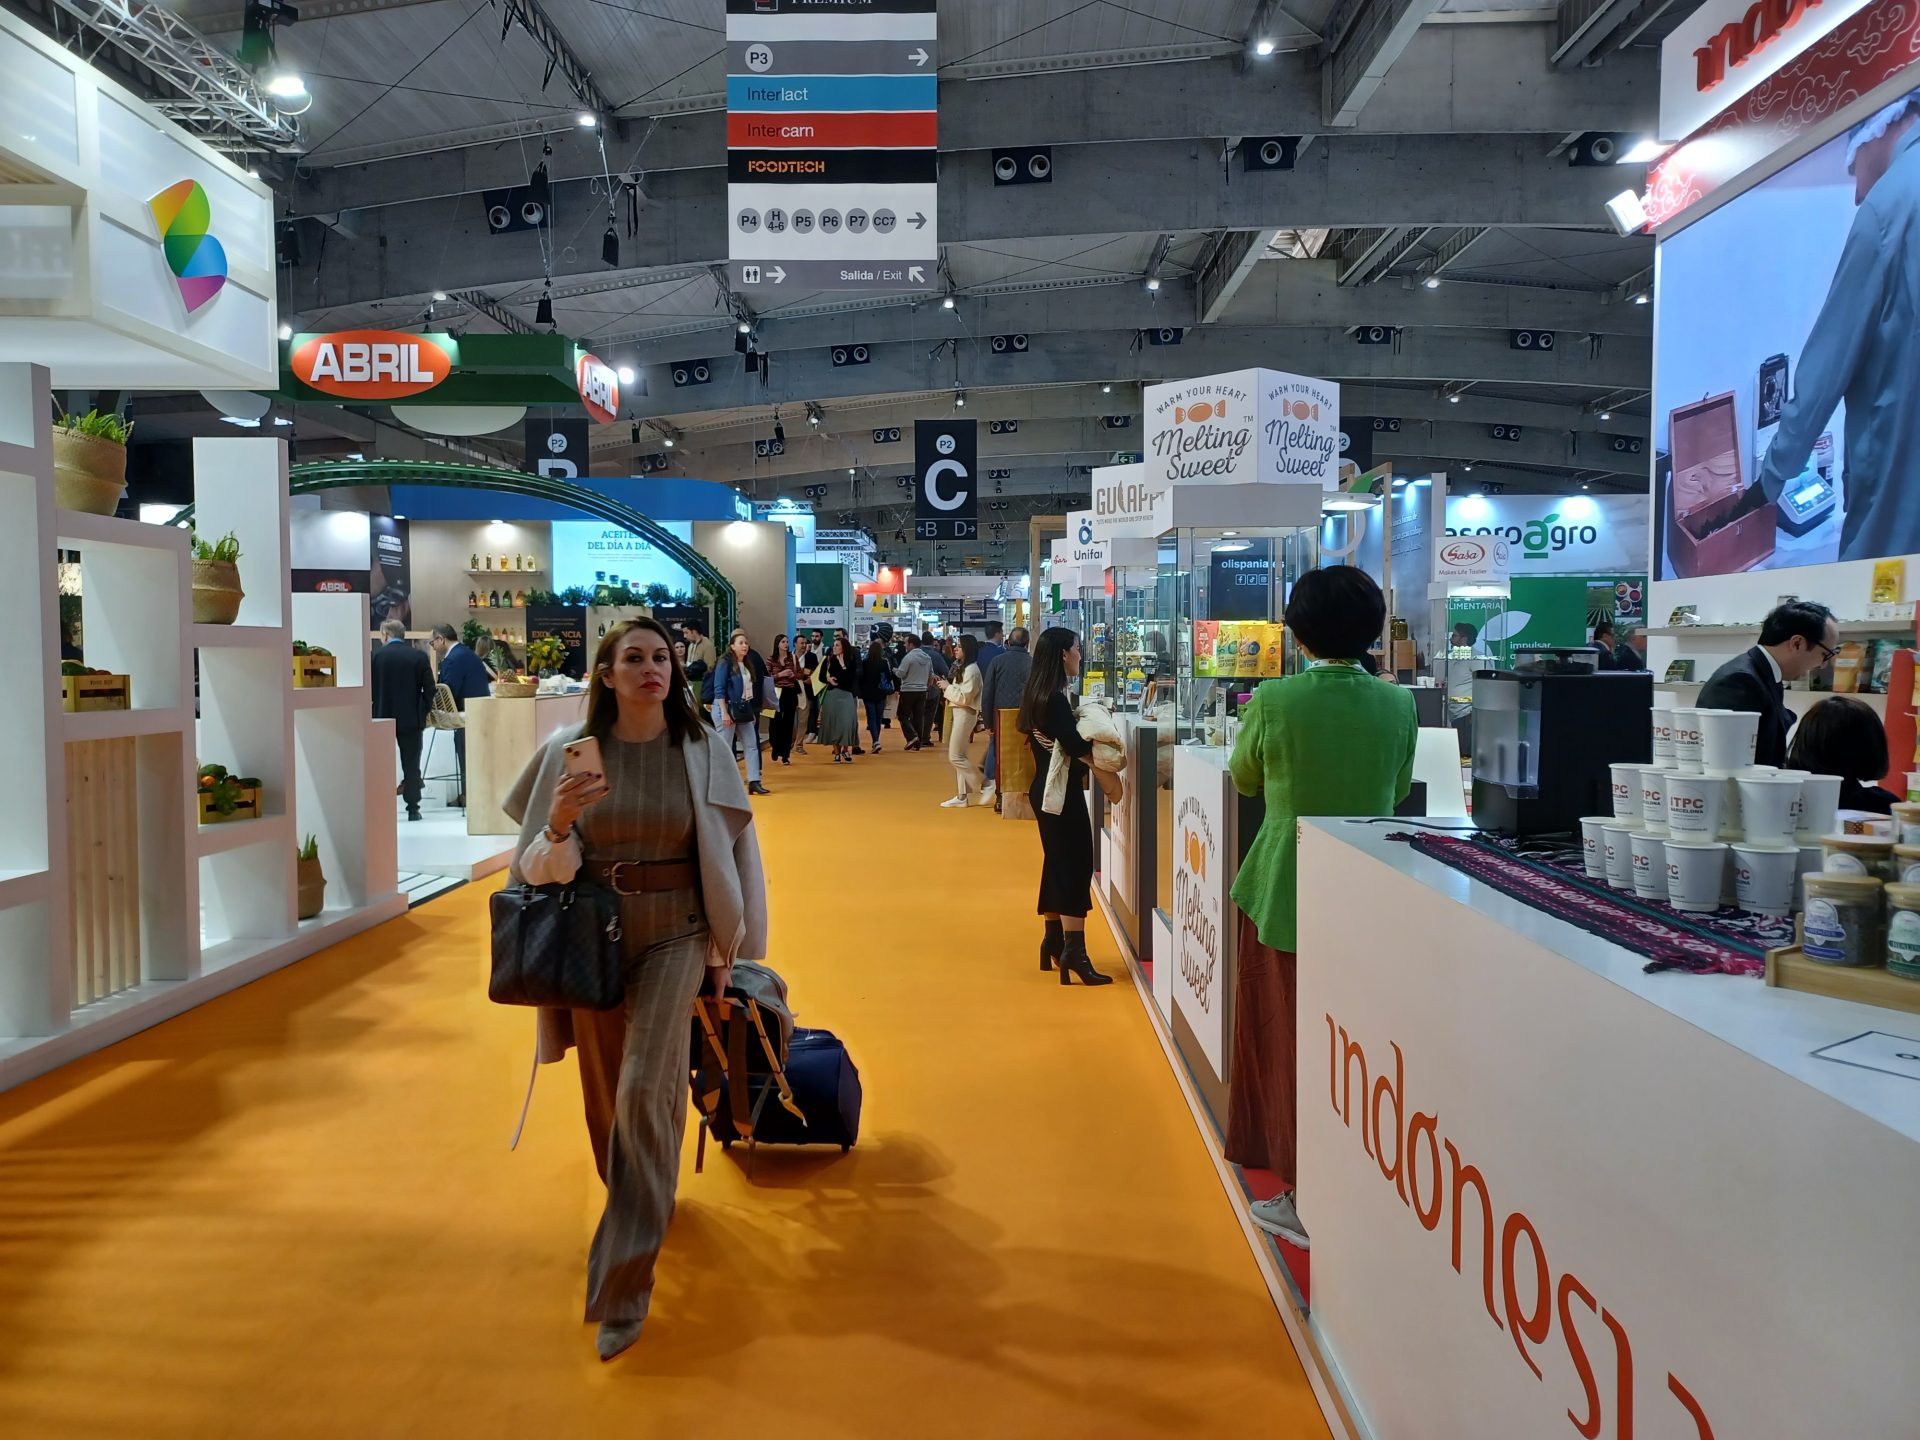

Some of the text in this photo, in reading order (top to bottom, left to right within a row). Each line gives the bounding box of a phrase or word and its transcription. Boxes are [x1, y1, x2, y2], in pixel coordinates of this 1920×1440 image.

[750, 52, 768, 64] P3
[747, 87, 808, 101] Interlact
[747, 123, 814, 137] Intercarn
[748, 160, 825, 173] FOODTECH
[741, 216, 757, 226] P4
[771, 211, 781, 221] H
[795, 216, 811, 227] P5
[822, 216, 839, 227] P6
[849, 216, 866, 226] P7
[873, 216, 896, 227] CC7
[767, 222, 785, 231] 4-6
[840, 269, 873, 281] Salida
[883, 270, 902, 281] Exit
[310, 343, 434, 382] ABRIL
[581, 364, 618, 417] ABRIL
[1268, 383, 1333, 411] WARM YOUR HEART
[1156, 385, 1247, 414] WARM YOUR HEART
[551, 439, 564, 448] P2
[940, 440, 953, 449] P2
[1152, 424, 1252, 457] Melting
[1265, 419, 1338, 462] Melting
[1166, 452, 1237, 480] Sweet
[1275, 446, 1326, 477] Sweet
[924, 458, 969, 511] C
[925, 522, 938, 537] B
[954, 522, 968, 536] D
[587, 542, 605, 550] DEL
[625, 542, 633, 550] A
[320, 581, 350, 592] ABRIL
[1675, 729, 1699, 740] TPC
[1188, 796, 1200, 816] YOUR
[1670, 796, 1704, 809] ITPC
[1176, 866, 1217, 981] Melting
[1181, 926, 1210, 1014] Sweet
